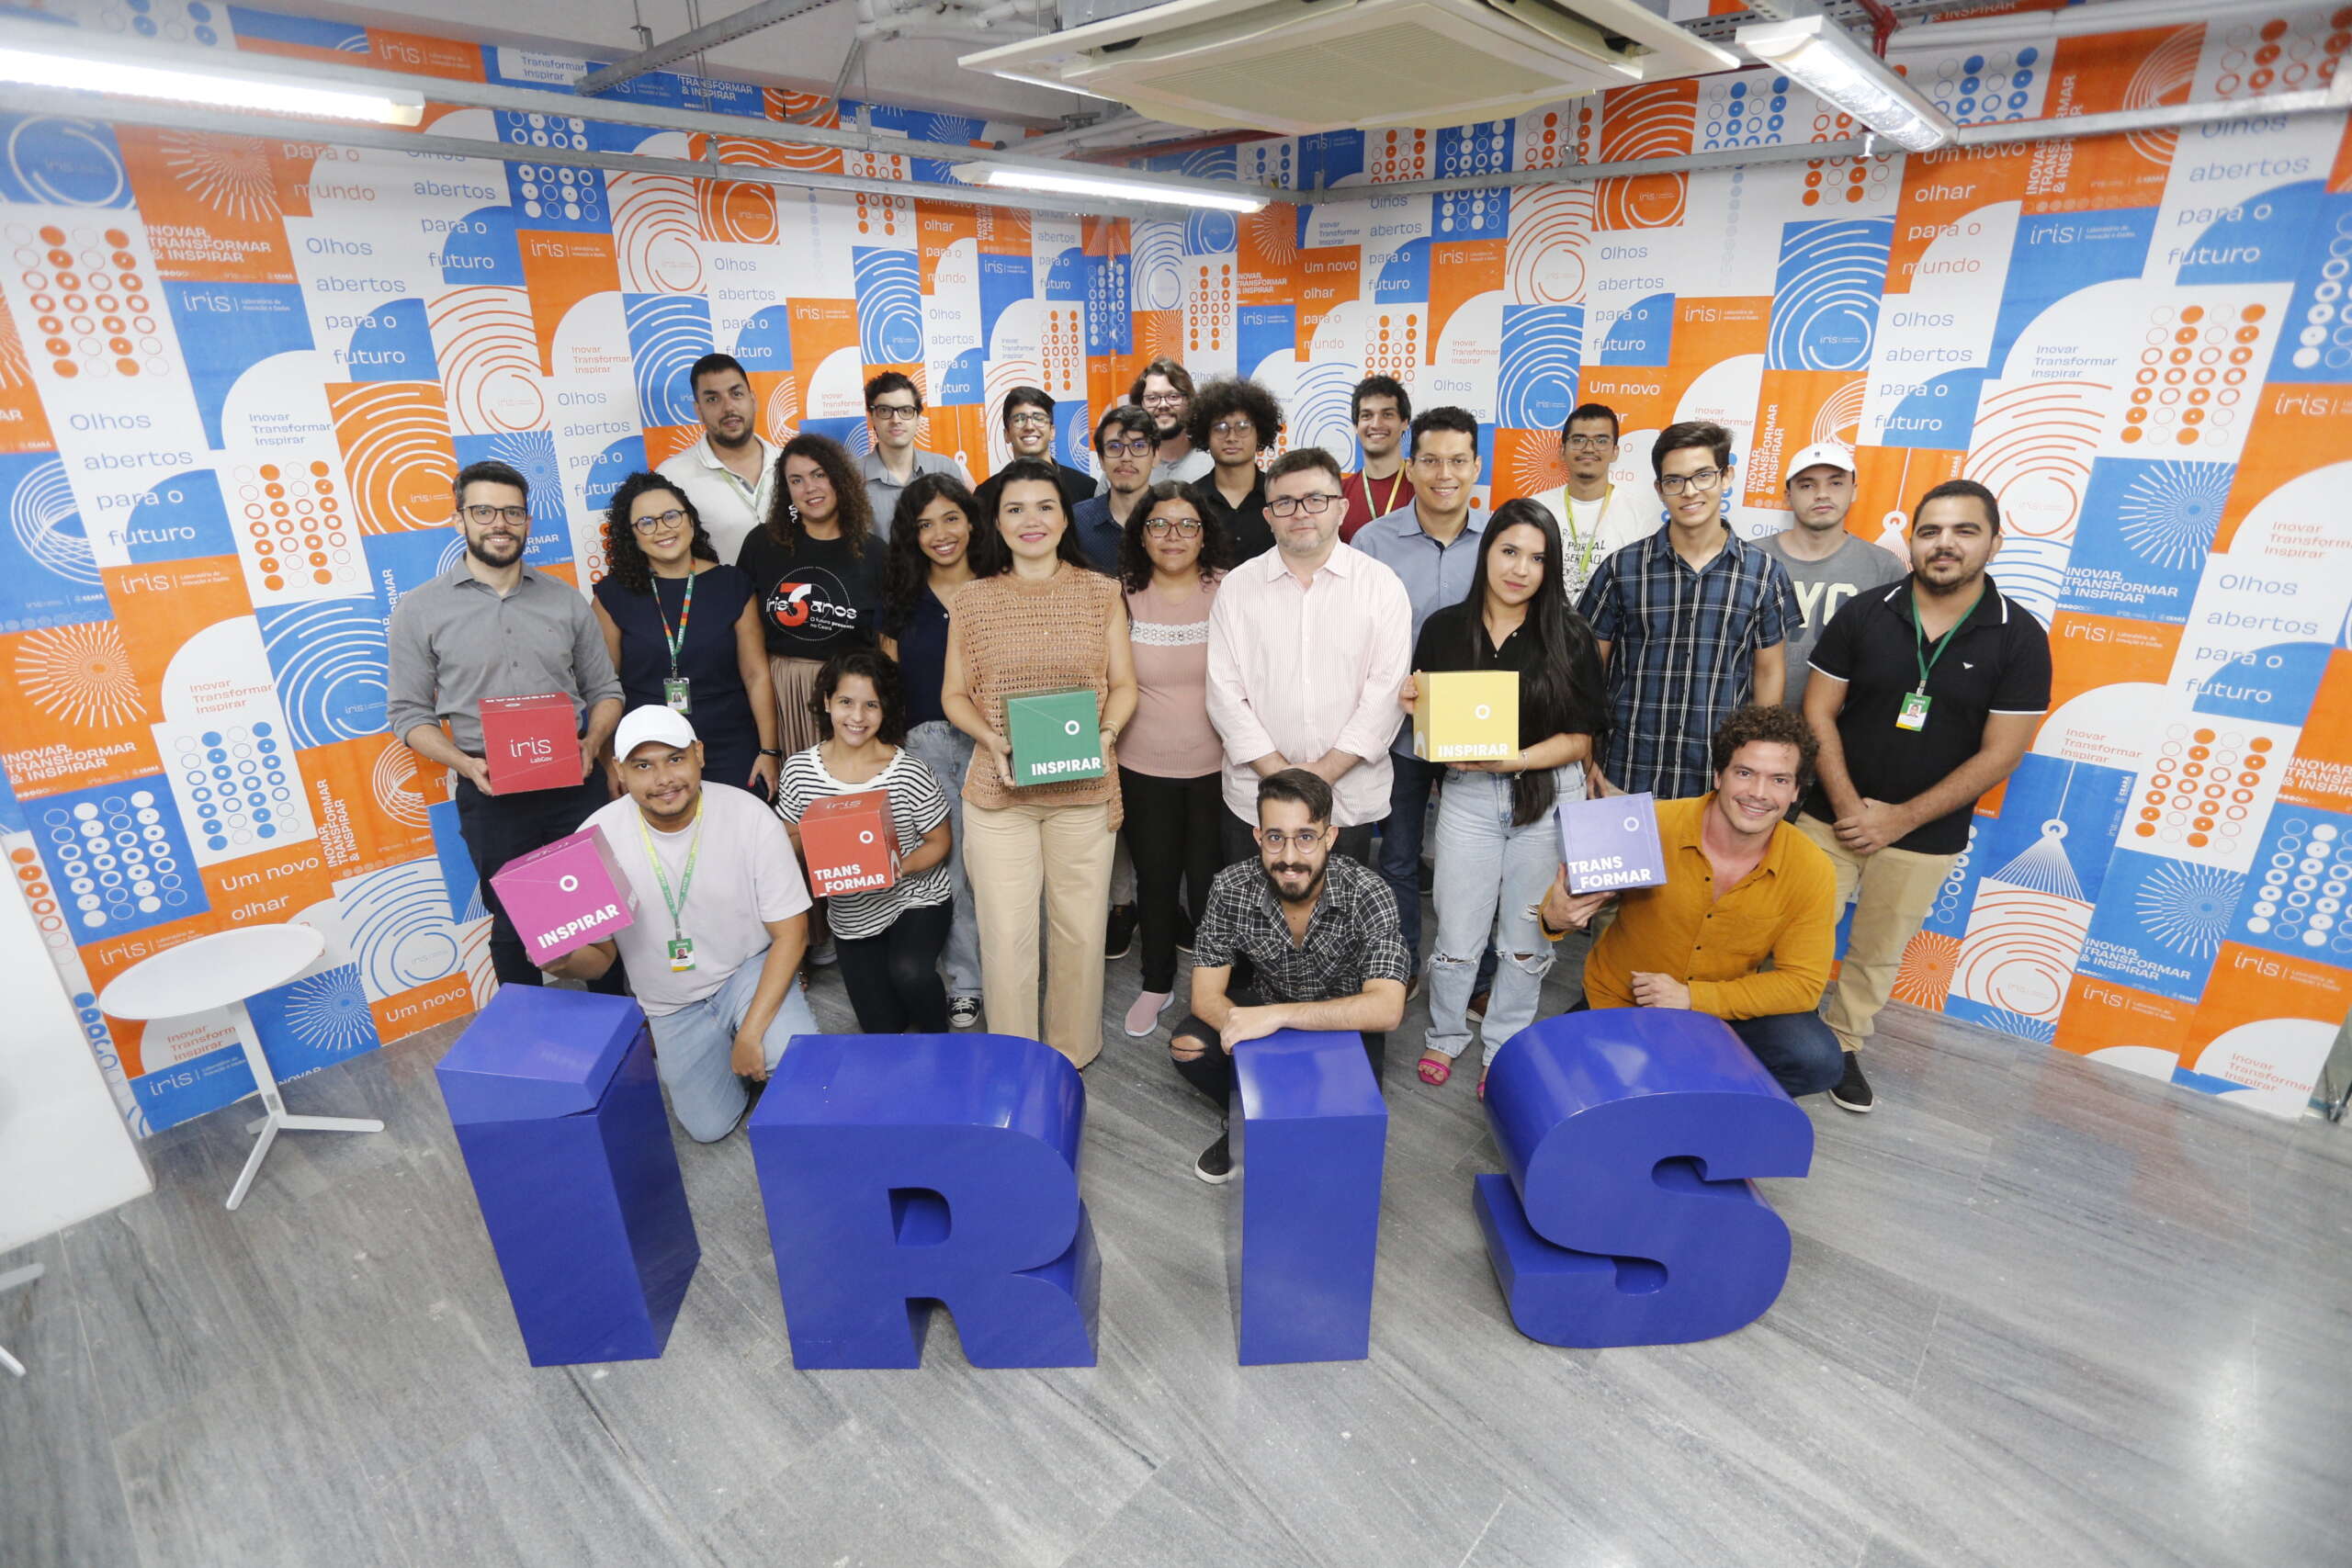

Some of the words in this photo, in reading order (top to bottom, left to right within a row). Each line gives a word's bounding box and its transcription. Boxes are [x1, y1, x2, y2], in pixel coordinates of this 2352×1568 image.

[379, 39, 422, 64] iris
[521, 56, 587, 73] Transformar
[524, 69, 565, 83] Inspirar
[680, 76, 753, 96] TRANSFORMAR
[283, 141, 338, 162] para
[1975, 141, 2027, 161] novo
[2188, 157, 2311, 183] abertos
[293, 184, 376, 202] mundo
[413, 180, 497, 200] abertos
[1915, 184, 1976, 202] olhar
[2177, 204, 2245, 227] para
[2253, 203, 2273, 221] o
[422, 219, 469, 233] para
[474, 220, 487, 234] o
[924, 220, 955, 232] olhar
[1318, 229, 1361, 237] Transformar
[1369, 222, 1422, 237] abertos
[1907, 223, 1960, 242] para
[1038, 231, 1076, 243] abertos
[2030, 225, 2075, 245] iris
[148, 235, 272, 254] TRANSFORMAR
[306, 237, 374, 256] Olhos
[530, 241, 563, 258] iris
[926, 245, 951, 258] para
[1600, 245, 1648, 261] Olhos
[168, 249, 245, 265] INSPIRAR
[428, 251, 495, 270] futuro
[714, 257, 757, 272] Olhos
[1039, 255, 1059, 267] para
[1369, 252, 1397, 265] para
[1439, 249, 1464, 265] iris
[2167, 246, 2261, 266] futuro
[984, 260, 1003, 274] iris
[1304, 261, 1324, 273] Um
[1328, 261, 1357, 272] novo
[1902, 258, 1981, 276] mundo
[316, 276, 407, 293] abertos
[926, 271, 967, 285] mundo
[1040, 277, 1071, 290] futuro
[1369, 277, 1410, 291] futuro
[1598, 276, 1665, 292] abertos
[183, 290, 232, 312] iris
[718, 288, 776, 302] abertos
[1304, 287, 1335, 299] olhar
[796, 305, 820, 321] iris
[929, 308, 961, 321] Olhos
[1242, 312, 1263, 325] iris
[1304, 314, 1329, 326] para
[1595, 308, 1633, 323] para
[1637, 308, 1648, 321] o
[1684, 304, 1716, 322] iris
[1892, 312, 1954, 328] Olhos
[325, 313, 376, 331] para
[382, 315, 398, 329] o
[722, 317, 753, 331] para
[932, 333, 975, 345] abertos
[1304, 337, 1345, 350] mundo
[1452, 339, 1477, 347] Inovar
[1593, 336, 1646, 352] futuro
[333, 348, 406, 367] futuro
[571, 345, 602, 355] Inovar
[726, 344, 773, 358] futuro
[1452, 347, 1499, 356] Transformar
[1886, 346, 1973, 363] abertos
[2036, 344, 2079, 355] Inovar
[573, 355, 631, 364] Transformar
[933, 358, 956, 370] para
[1451, 356, 1481, 366] Inspirar
[2034, 355, 2118, 367] Transformar
[575, 366, 611, 375] Inspirar
[2030, 368, 2084, 380] Inspirar
[934, 381, 970, 394] futuro
[1433, 378, 1472, 392] Olhos
[1589, 380, 1617, 394] Um
[1621, 382, 1660, 395] novo
[1880, 383, 1928, 398] para
[1934, 384, 1949, 398] o
[558, 392, 607, 406] Olhos
[2274, 392, 2329, 416] iris
[249, 412, 291, 423] Inovar
[1694, 407, 1725, 416] Inovar
[70, 412, 152, 433] Olhos
[252, 422, 333, 435] Transformar
[564, 421, 631, 436] abertos
[1874, 414, 1943, 432] futuro
[255, 435, 306, 447] Inspirar
[1755, 403, 1779, 494] TRANSFORMAR
[84, 449, 193, 471] abertos
[570, 454, 608, 469] para
[613, 452, 624, 464] o
[1766, 427, 1785, 483] INSPIRAR
[96, 491, 161, 512] para
[167, 489, 185, 504] o
[2272, 521, 2324, 534] Inovar
[107, 526, 196, 547] futuro
[1567, 539, 1606, 552] PORAL
[2264, 546, 2326, 560] Inspirar
[120, 572, 170, 594] iris
[2066, 567, 2124, 583] INOVAR,
[2064, 577, 2178, 598] TRANSFORMAR
[2219, 574, 2298, 596] Olhos
[2075, 587, 2145, 604] INSPIRAR
[809, 599, 857, 620] anos
[1792, 581, 1859, 629] YC
[2064, 620, 2106, 642] iris
[2207, 612, 2318, 636] abertos
[2196, 646, 2256, 666] para
[2266, 654, 2283, 669] o
[189, 681, 232, 693] Inovar
[191, 683, 274, 704] Transformar
[2185, 678, 2272, 705] futuro
[196, 701, 247, 715] Inspirar
[2066, 728, 2107, 741] Inovar
[2, 743, 73, 763] INOVAR,
[509, 736, 552, 758] iris
[1438, 743, 1509, 758] INSPIRAR
[2064, 738, 2143, 759] Transformar
[5, 741, 137, 773] TRANSFORMAR
[2060, 748, 2110, 764] Inspirar
[28, 758, 108, 783] INSPIRAR
[1031, 756, 1102, 777] INSPIRAR
[315, 779, 345, 866] TRANSFORMAR
[813, 863, 862, 882] TRANS
[1568, 855, 1623, 874] TRANS
[220, 874, 261, 892] Um
[266, 856, 320, 879] novo
[231, 894, 289, 921] olhar
[537, 903, 620, 949] INSPIRAR
[99, 939, 148, 966] iris
[2085, 938, 2140, 959] INOVAR,
[2082, 945, 2191, 980] TRANSFORMAR
[2093, 957, 2160, 982] INSPIRAR
[2233, 952, 2280, 977] iris
[386, 1005, 418, 1022] Um
[423, 987, 467, 1009] novo
[2083, 984, 2123, 1009] iris
[167, 1024, 208, 1043] Inovar
[175, 1041, 223, 1062] Inspirar
[2232, 1053, 2276, 1071] Inovar
[150, 1070, 193, 1096] iris
[2224, 1071, 2279, 1092] Inspirar
[2228, 1063, 2313, 1091] Transformar
